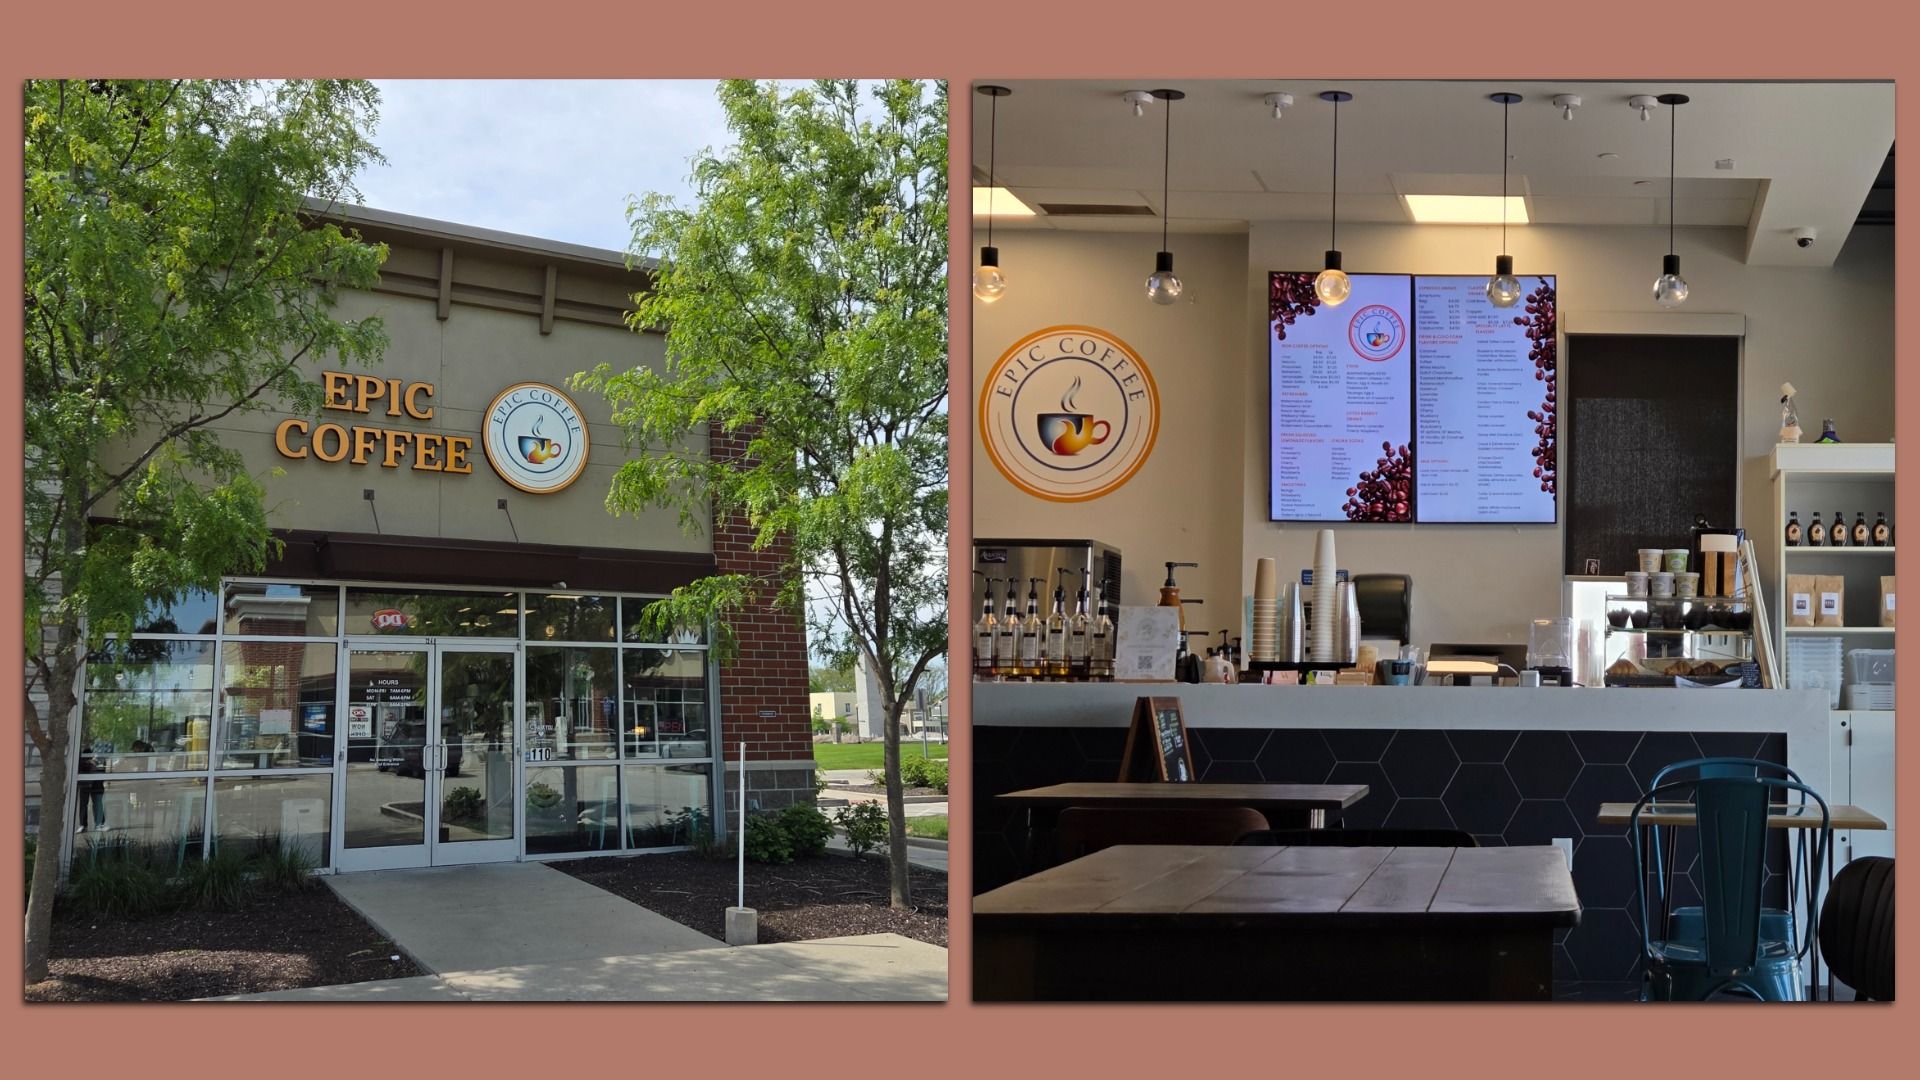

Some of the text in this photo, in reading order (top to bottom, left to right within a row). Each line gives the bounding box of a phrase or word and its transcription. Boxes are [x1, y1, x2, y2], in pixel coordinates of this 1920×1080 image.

[996, 337, 1146, 403] EPIC COFFEE
[322, 371, 435, 420] EPIC
[492, 389, 581, 435] EPIC COFFEE
[275, 419, 473, 475] COFFEE
[531, 748, 551, 761] 110
